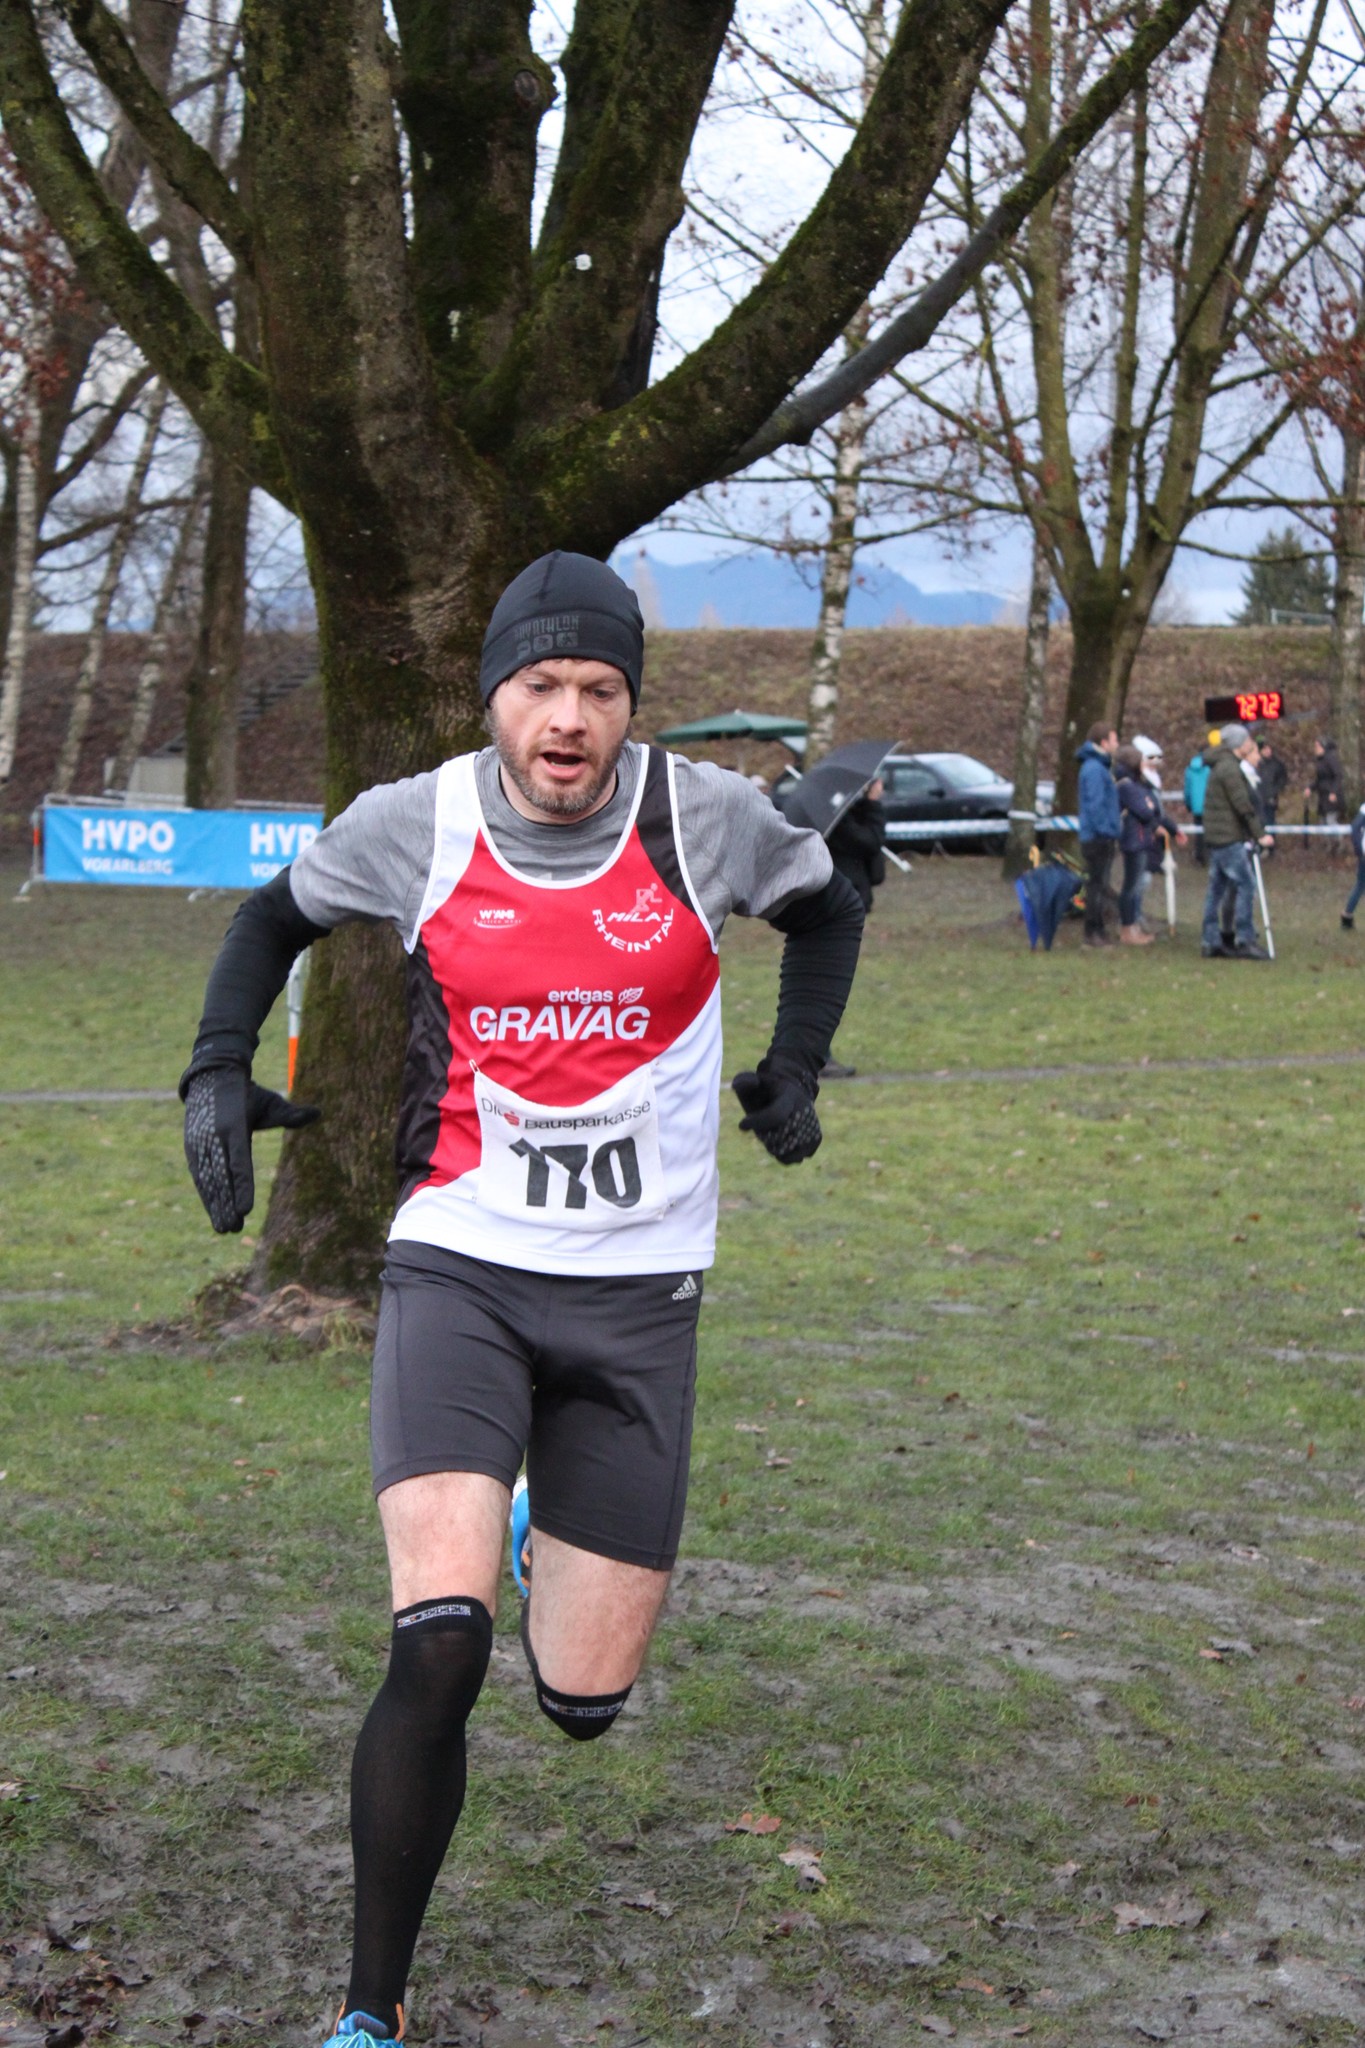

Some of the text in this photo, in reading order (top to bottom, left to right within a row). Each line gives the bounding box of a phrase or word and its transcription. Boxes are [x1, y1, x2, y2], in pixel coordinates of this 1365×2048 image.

[250, 822, 320, 857] HYP
[592, 908, 674, 953] RHEINTAL
[548, 987, 613, 1005] erdgas
[470, 1006, 651, 1042] GRAVAG
[524, 1100, 651, 1130] Bausparkasse
[509, 1136, 642, 1209] 170
[672, 1289, 699, 1301] adida
